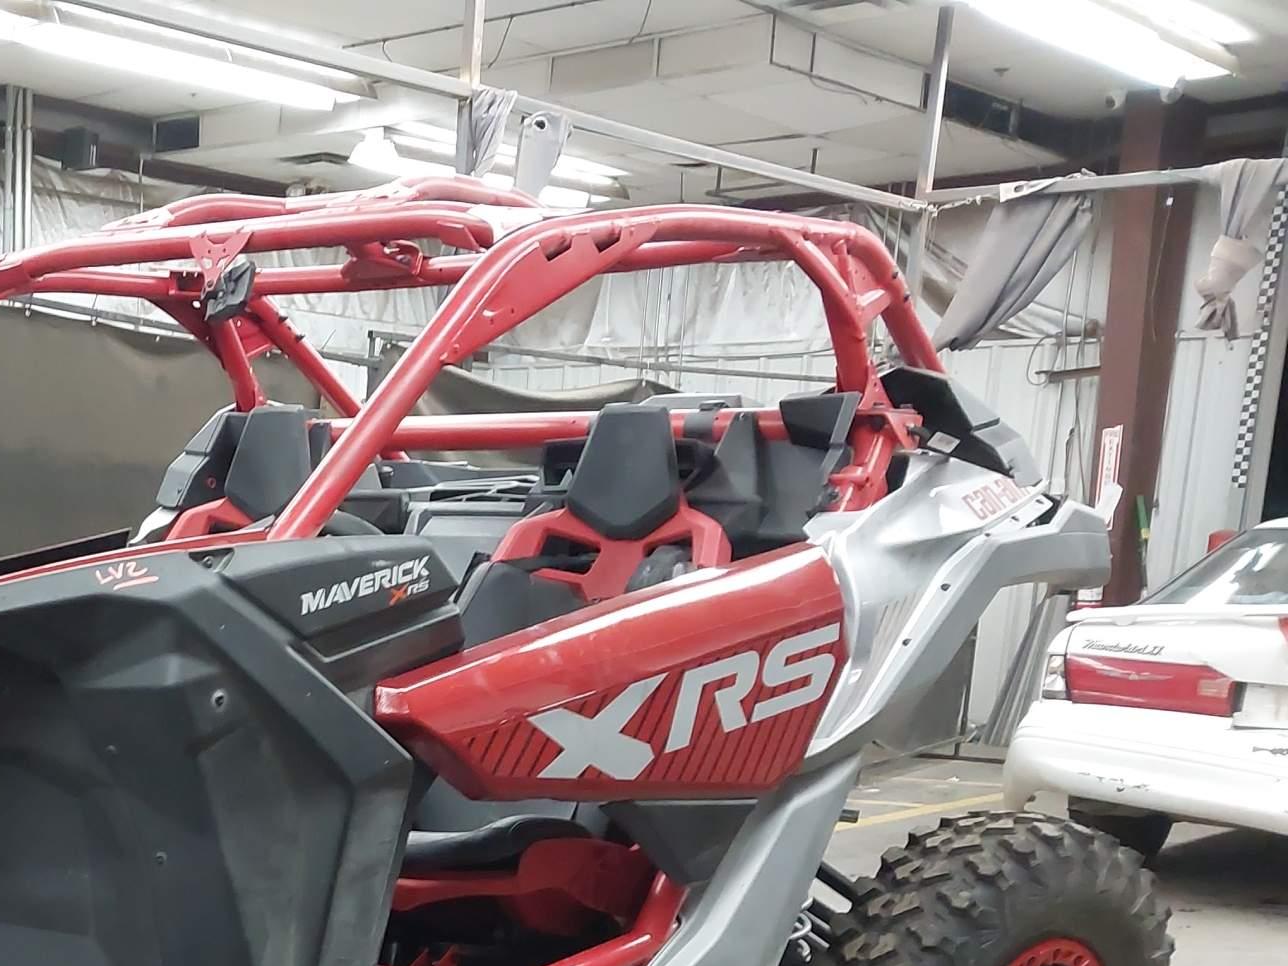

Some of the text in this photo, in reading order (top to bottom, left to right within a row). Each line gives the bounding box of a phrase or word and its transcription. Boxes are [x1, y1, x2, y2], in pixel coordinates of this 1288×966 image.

[300, 555, 430, 616] MAVERICK
[388, 580, 430, 607] XRS
[526, 621, 841, 781] XRS
